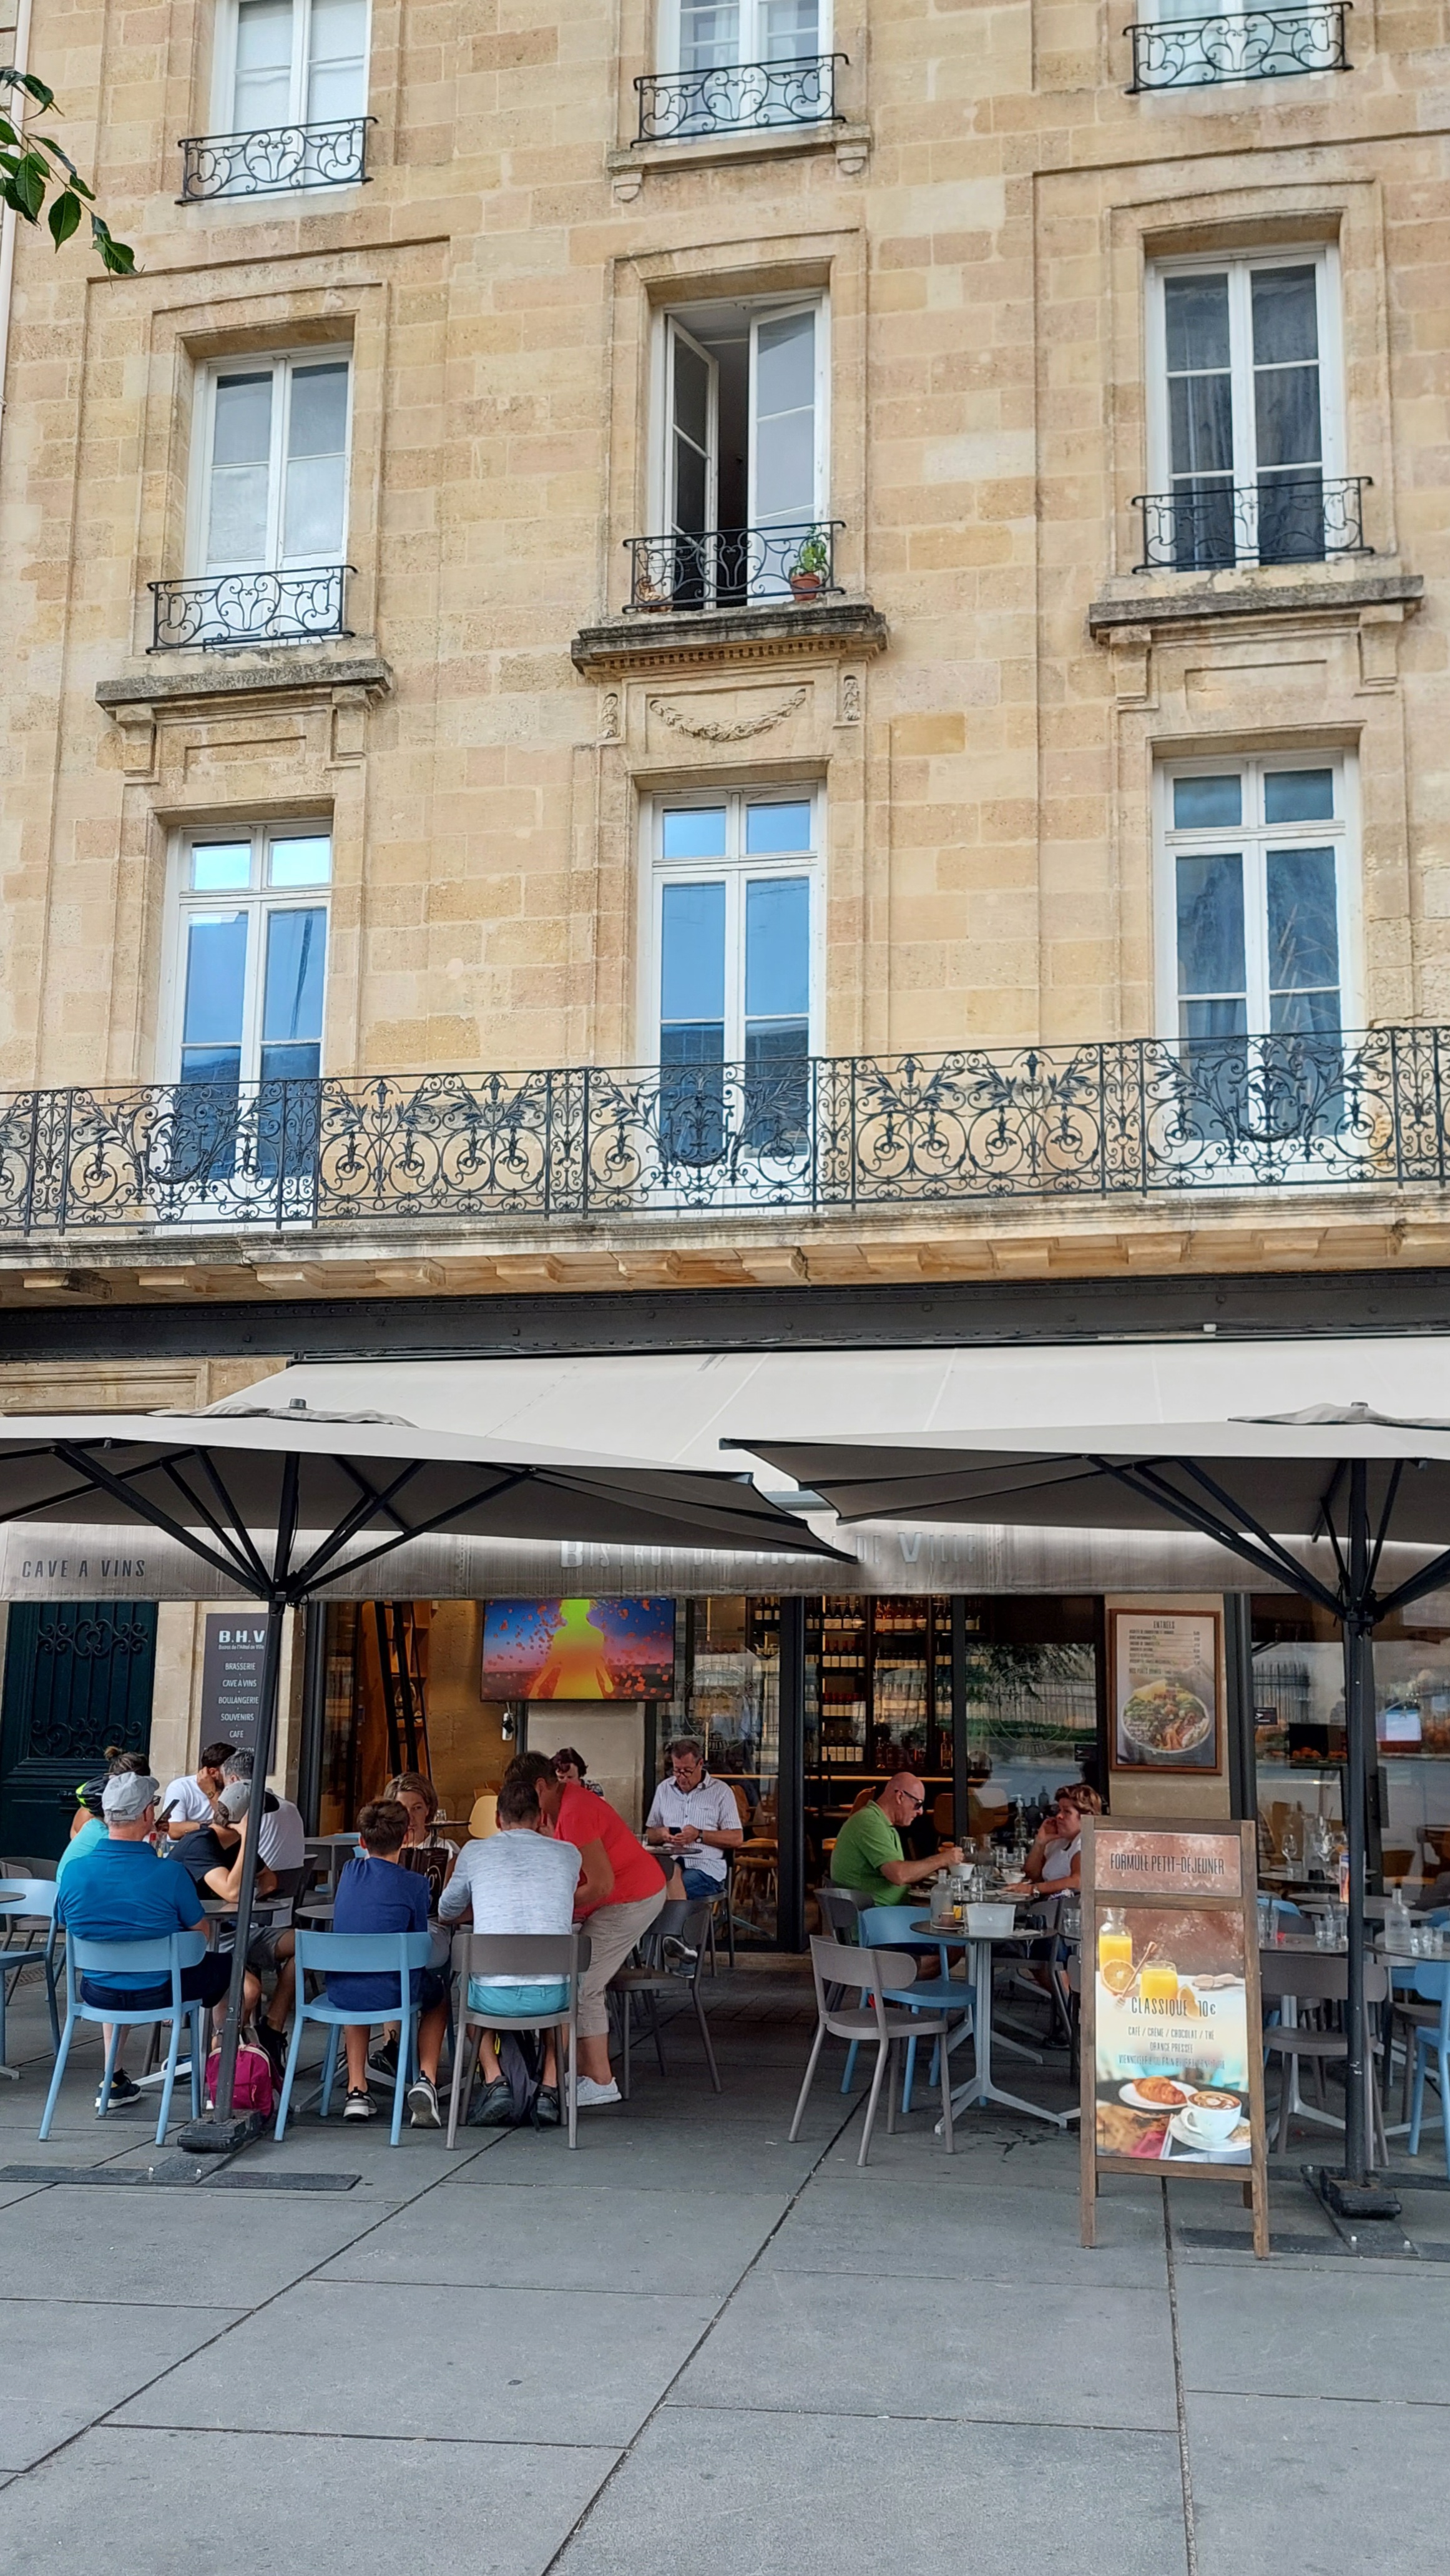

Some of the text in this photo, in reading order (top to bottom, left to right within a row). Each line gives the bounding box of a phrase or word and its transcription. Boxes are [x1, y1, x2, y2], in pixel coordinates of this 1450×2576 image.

[898, 1531, 976, 1563] VILLE
[22, 1560, 145, 1577] CAVE A VINS
[218, 1630, 265, 1643] B.H.V
[225, 1663, 256, 1671] BRASSERIE
[222, 1679, 238, 1688] CAVE
[243, 1678, 257, 1688] VINS
[218, 1696, 259, 1704] BOULANGERIE
[220, 1713, 255, 1721] SOUVENIRS
[1110, 1853, 1224, 1874] FORMULE PETIT-DÉJEUNER
[1131, 1997, 1187, 2017] CLASSIQUE
[1128, 2026, 1140, 2037] CAFÉ
[1171, 2028, 1197, 2039] CHOCOLAT
[1150, 2042, 1170, 2052] ORANGE
